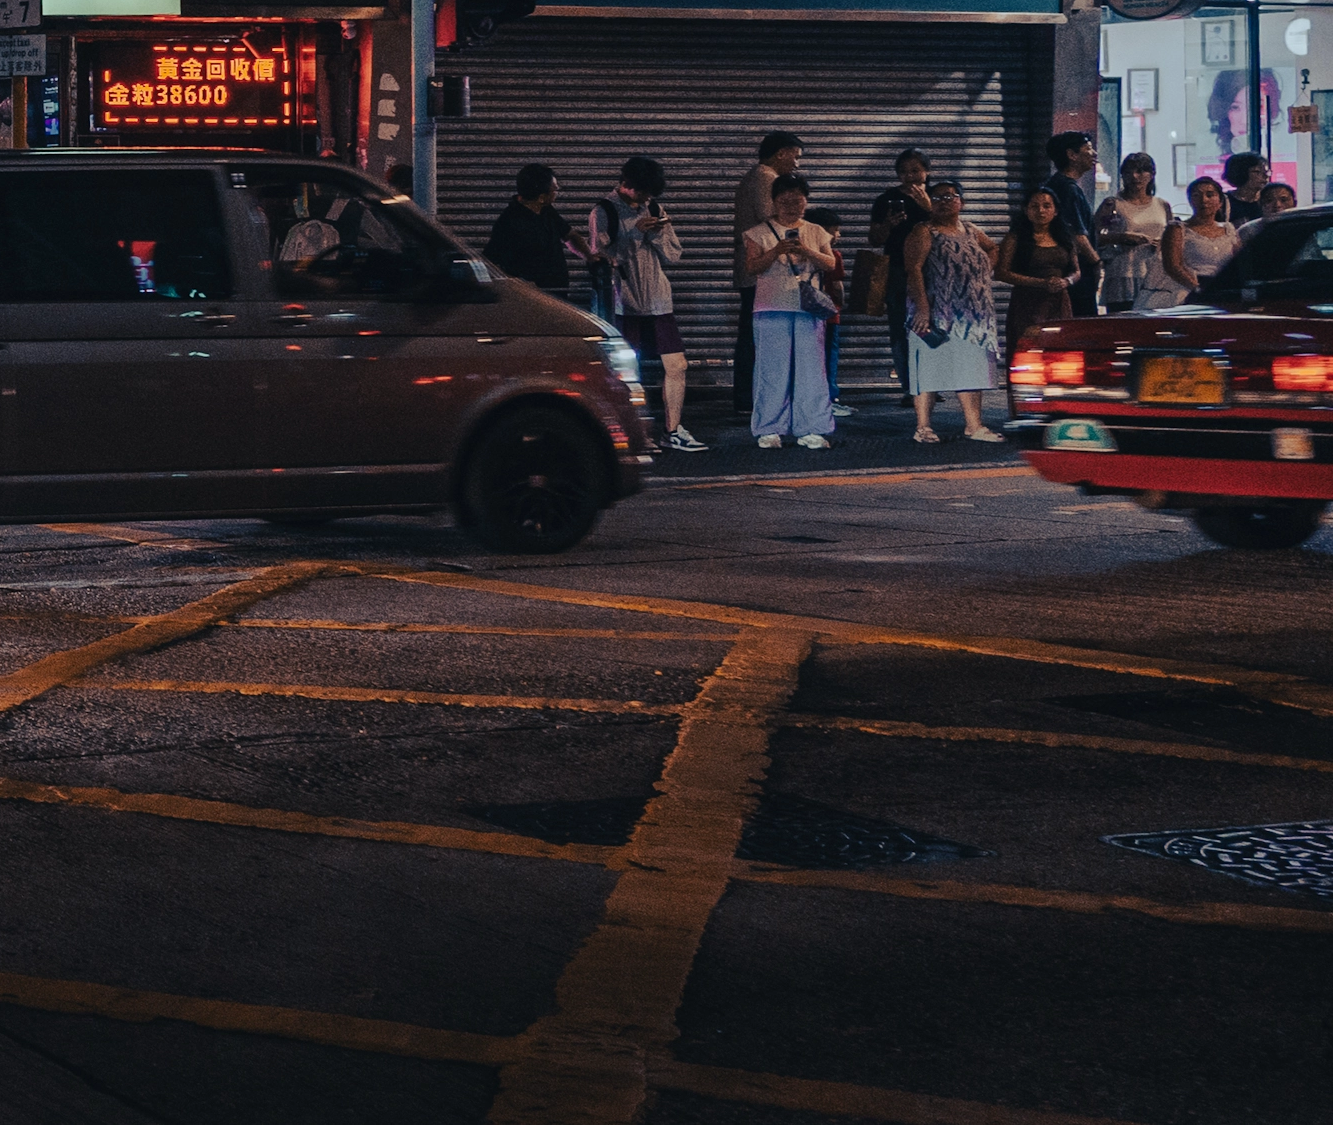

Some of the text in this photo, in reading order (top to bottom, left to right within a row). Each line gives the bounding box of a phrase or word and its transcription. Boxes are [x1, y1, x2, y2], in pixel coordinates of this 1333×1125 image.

[19, 1, 29, 23] 7
[17, 38, 30, 47] taxi
[28, 48, 39, 57] off
[107, 83, 228, 106] 金粒38600
